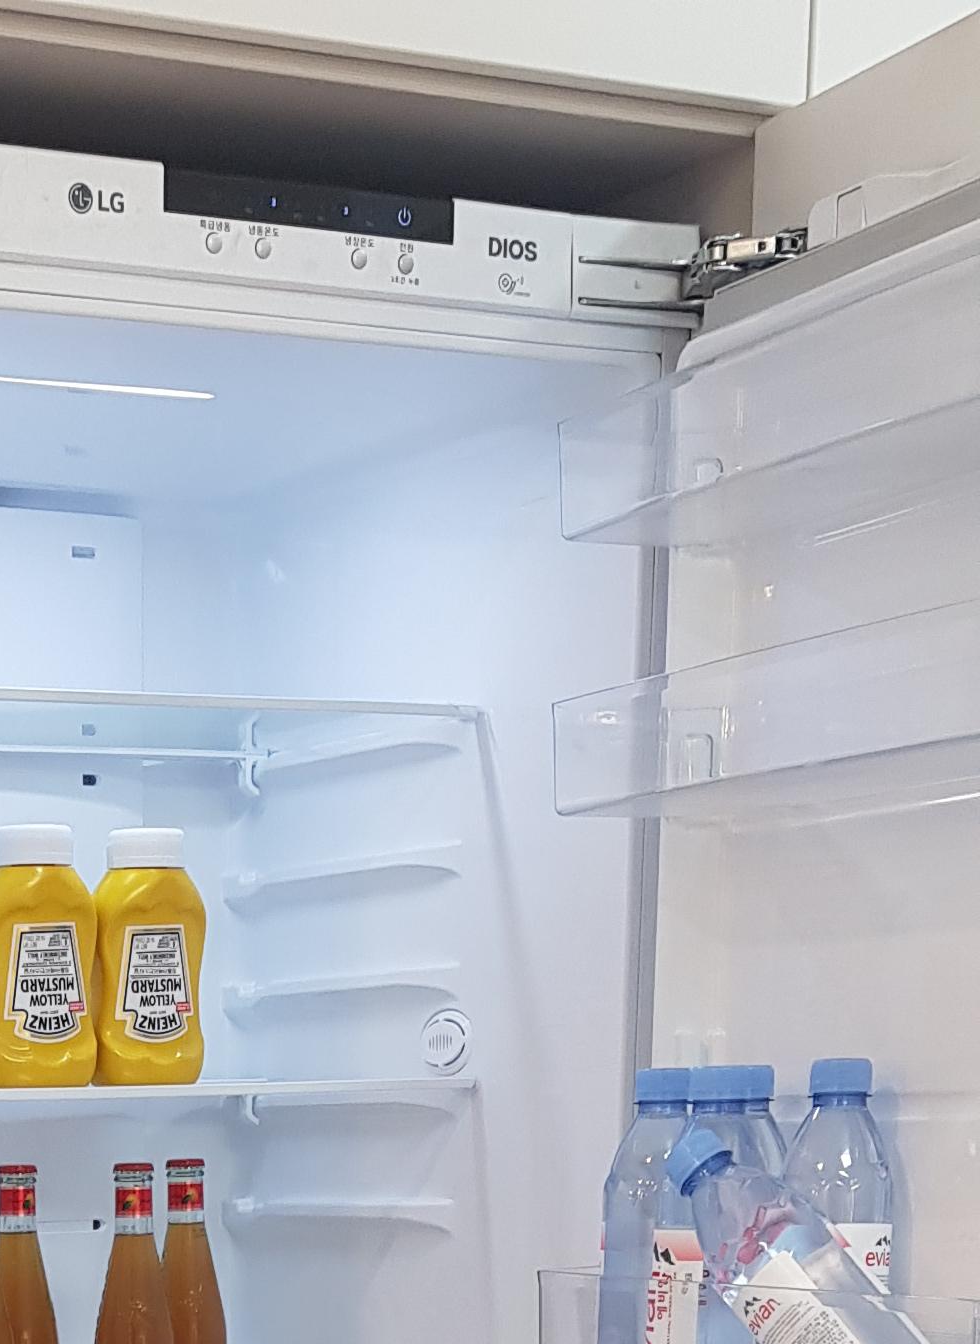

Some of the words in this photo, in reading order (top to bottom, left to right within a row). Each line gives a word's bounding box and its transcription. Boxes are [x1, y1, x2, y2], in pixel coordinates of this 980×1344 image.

[488, 236, 538, 262] DIOS
[20, 977, 74, 993] MUSTARD
[131, 978, 182, 993] MUSTARD
[29, 994, 69, 1008] YELLOW
[139, 994, 177, 1008] YELLOW
[29, 1012, 71, 1031] HEINZ
[139, 1013, 178, 1031] HEINZ
